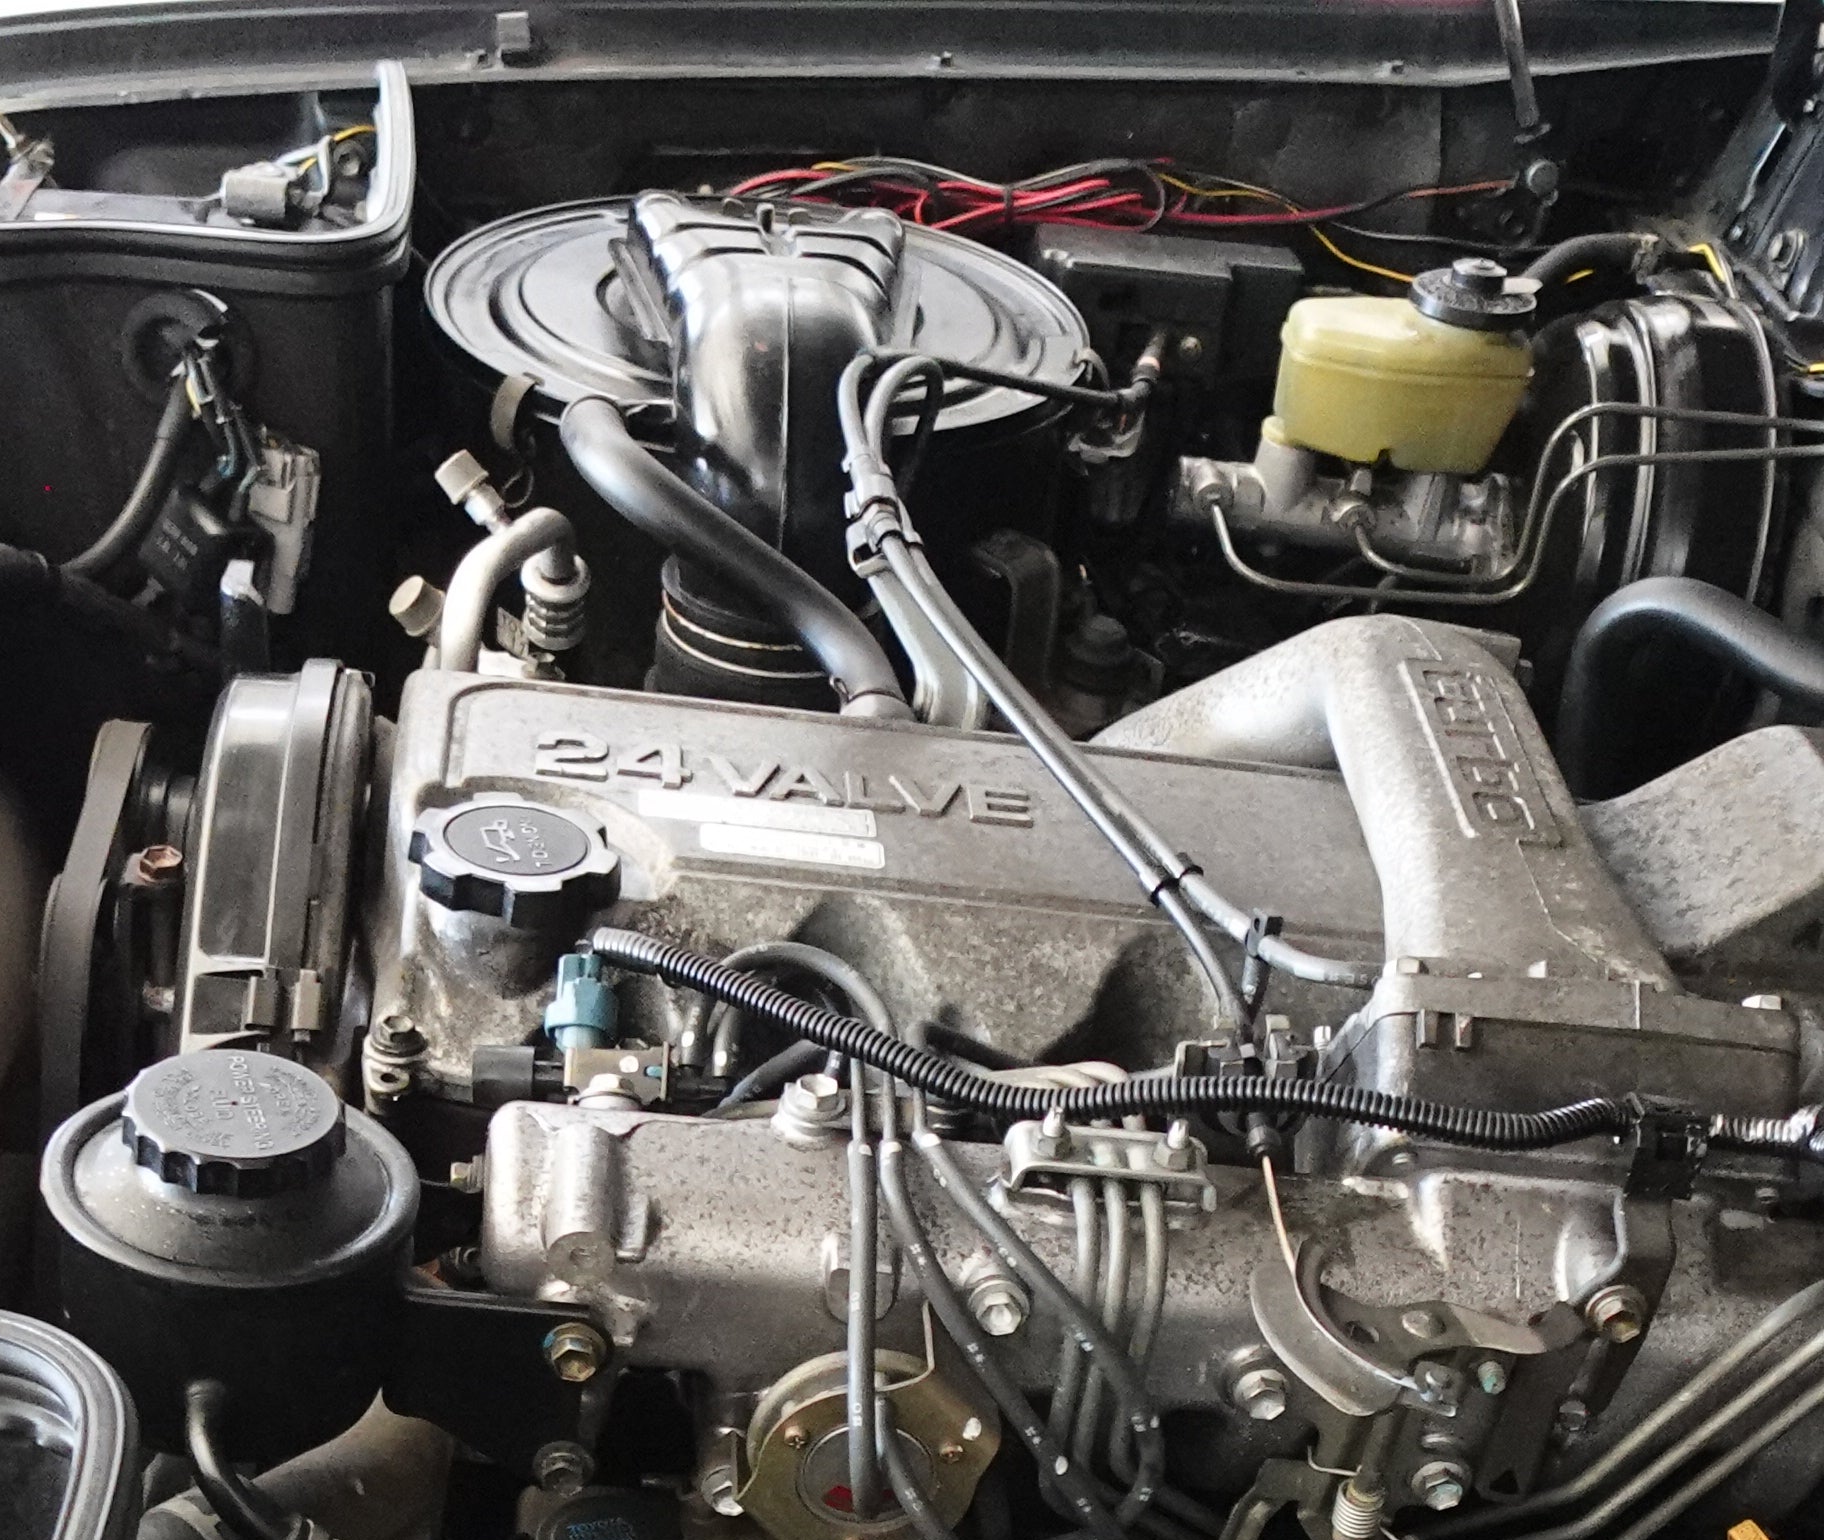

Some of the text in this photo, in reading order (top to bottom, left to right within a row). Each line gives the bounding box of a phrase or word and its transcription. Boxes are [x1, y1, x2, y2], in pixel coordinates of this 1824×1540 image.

[533, 729, 694, 790] 24
[707, 752, 1035, 829] VALVE
[227, 1055, 275, 1150] POWER STEERING
